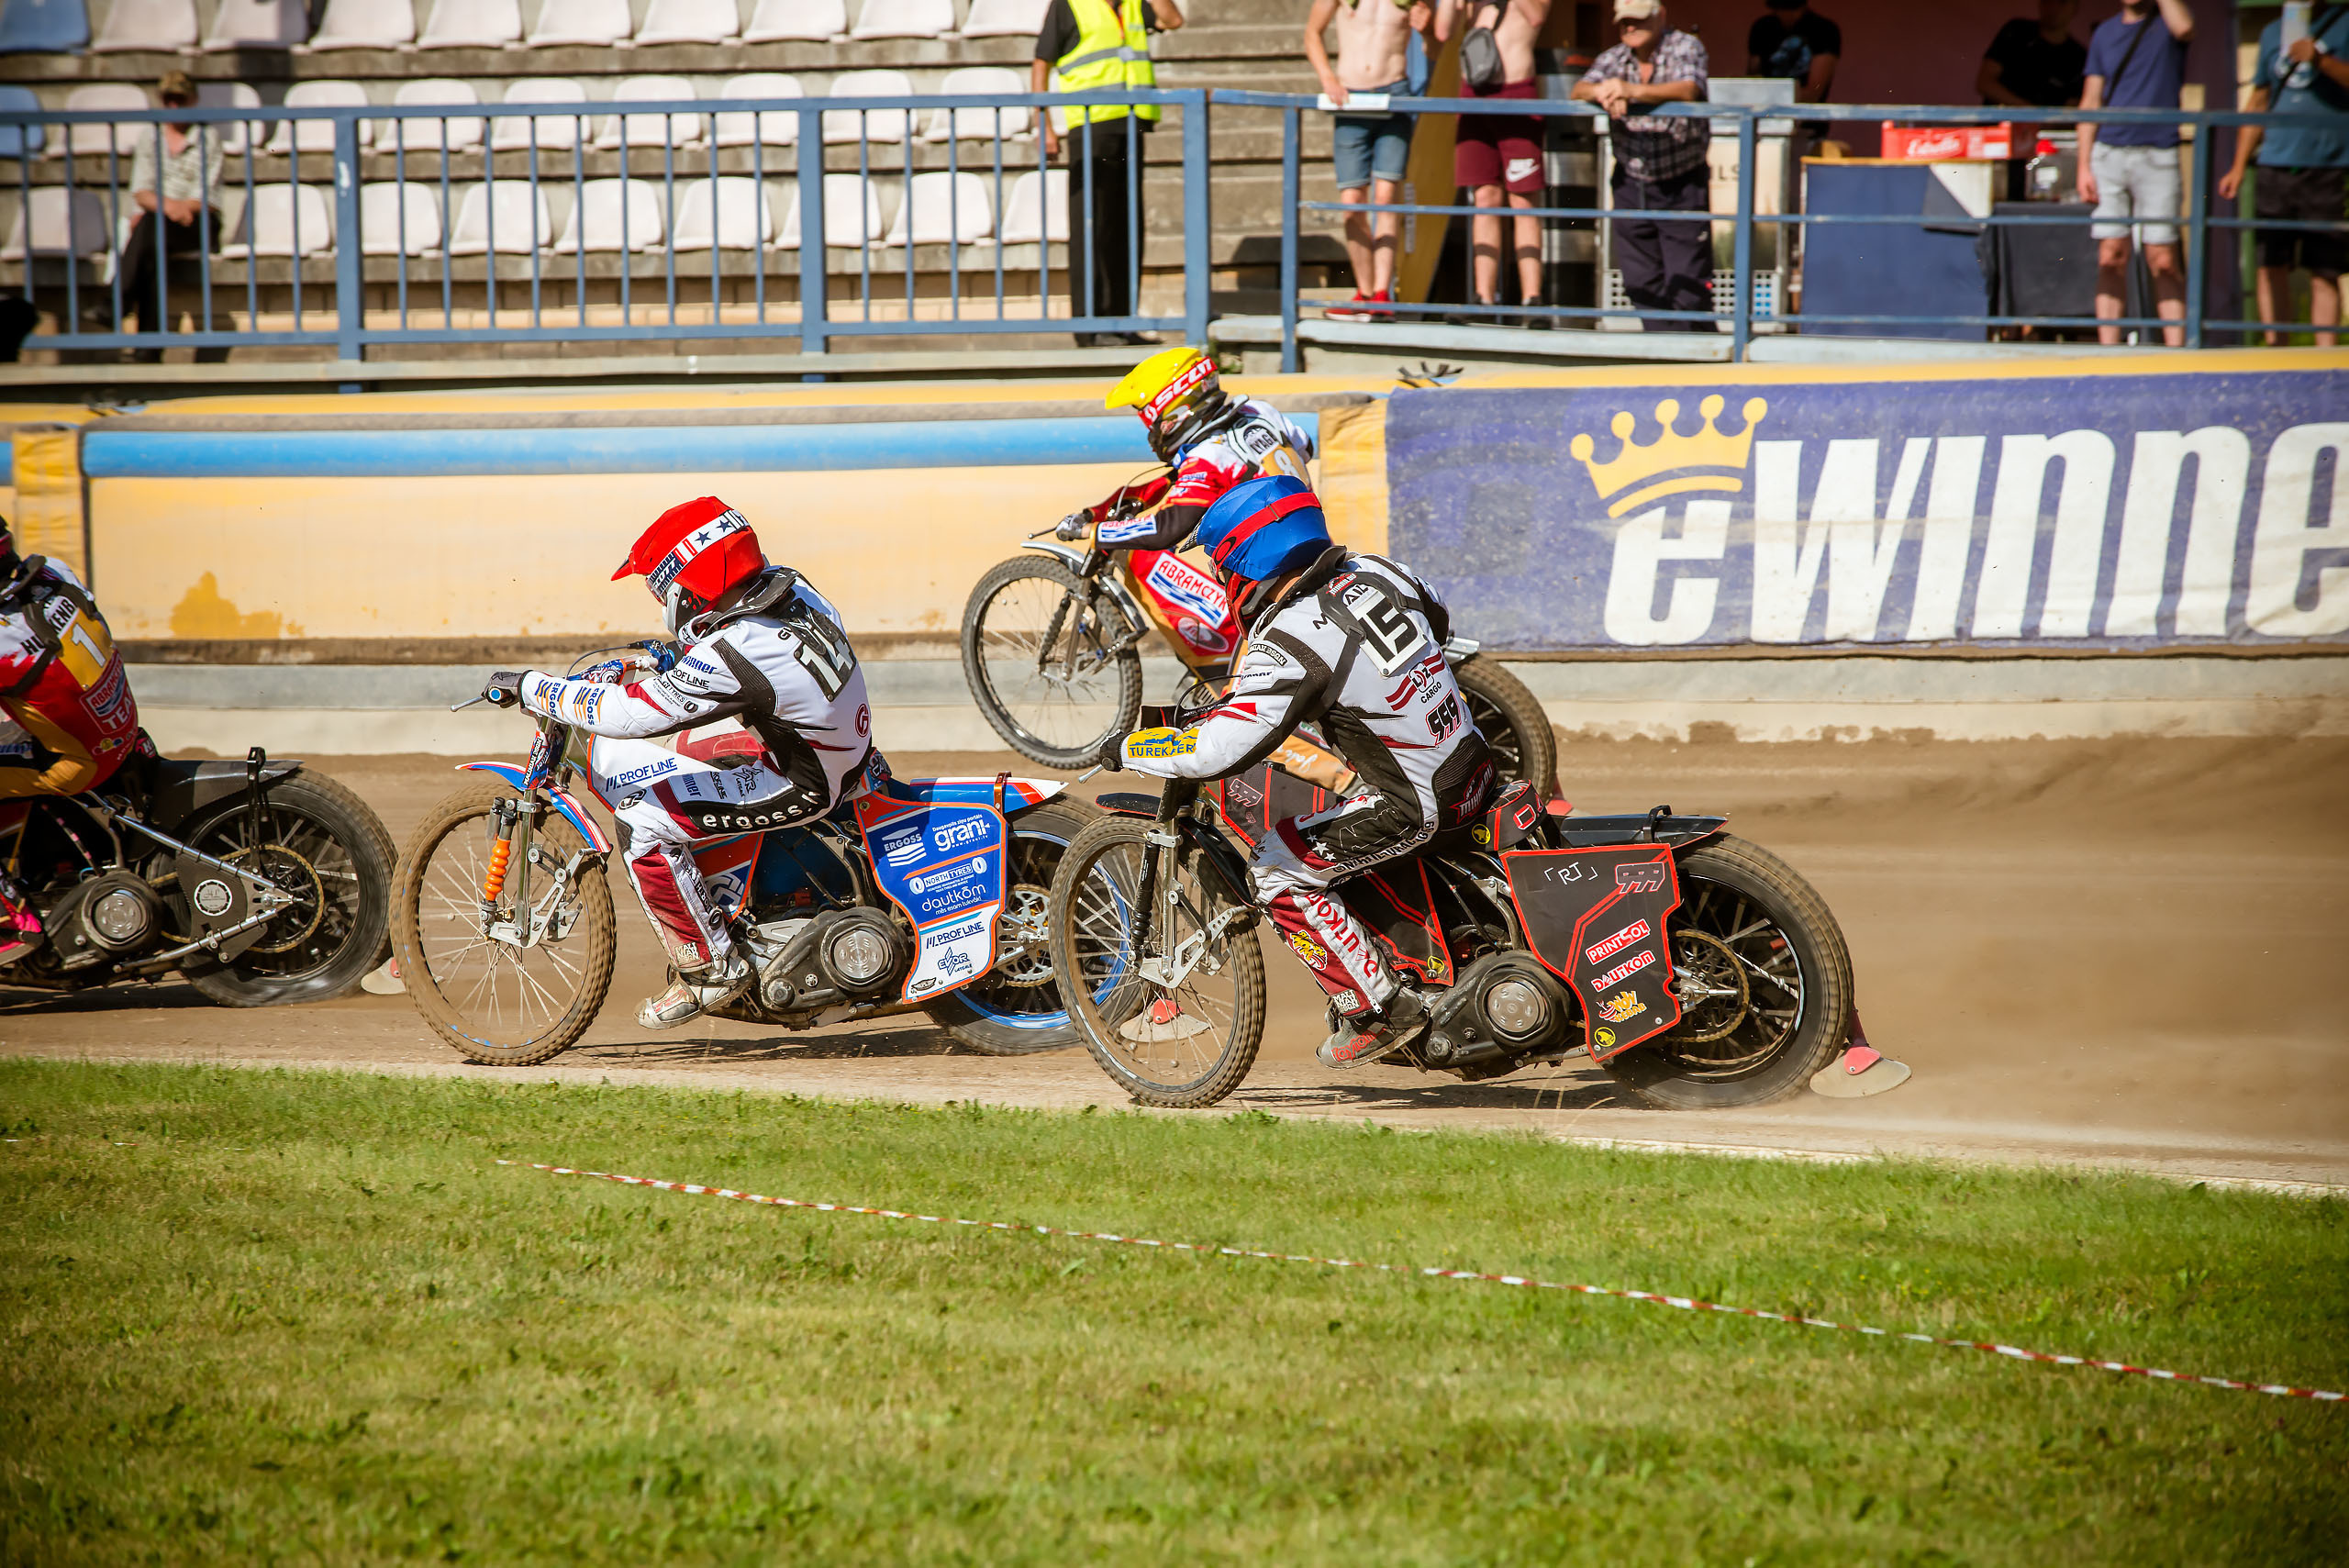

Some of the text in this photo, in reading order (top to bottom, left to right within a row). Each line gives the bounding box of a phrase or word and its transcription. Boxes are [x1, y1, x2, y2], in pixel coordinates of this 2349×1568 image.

[1358, 596, 1419, 663] 15
[72, 623, 106, 668] 1
[1420, 681, 1442, 704] CARGO
[884, 833, 922, 851] ERGOSS
[925, 873, 949, 886] NORTH
[949, 865, 972, 878] TYRES
[1588, 924, 1649, 962] PRINTSOL
[1606, 990, 1638, 1012] WOW
[1613, 1002, 1648, 1022] KEBAB
